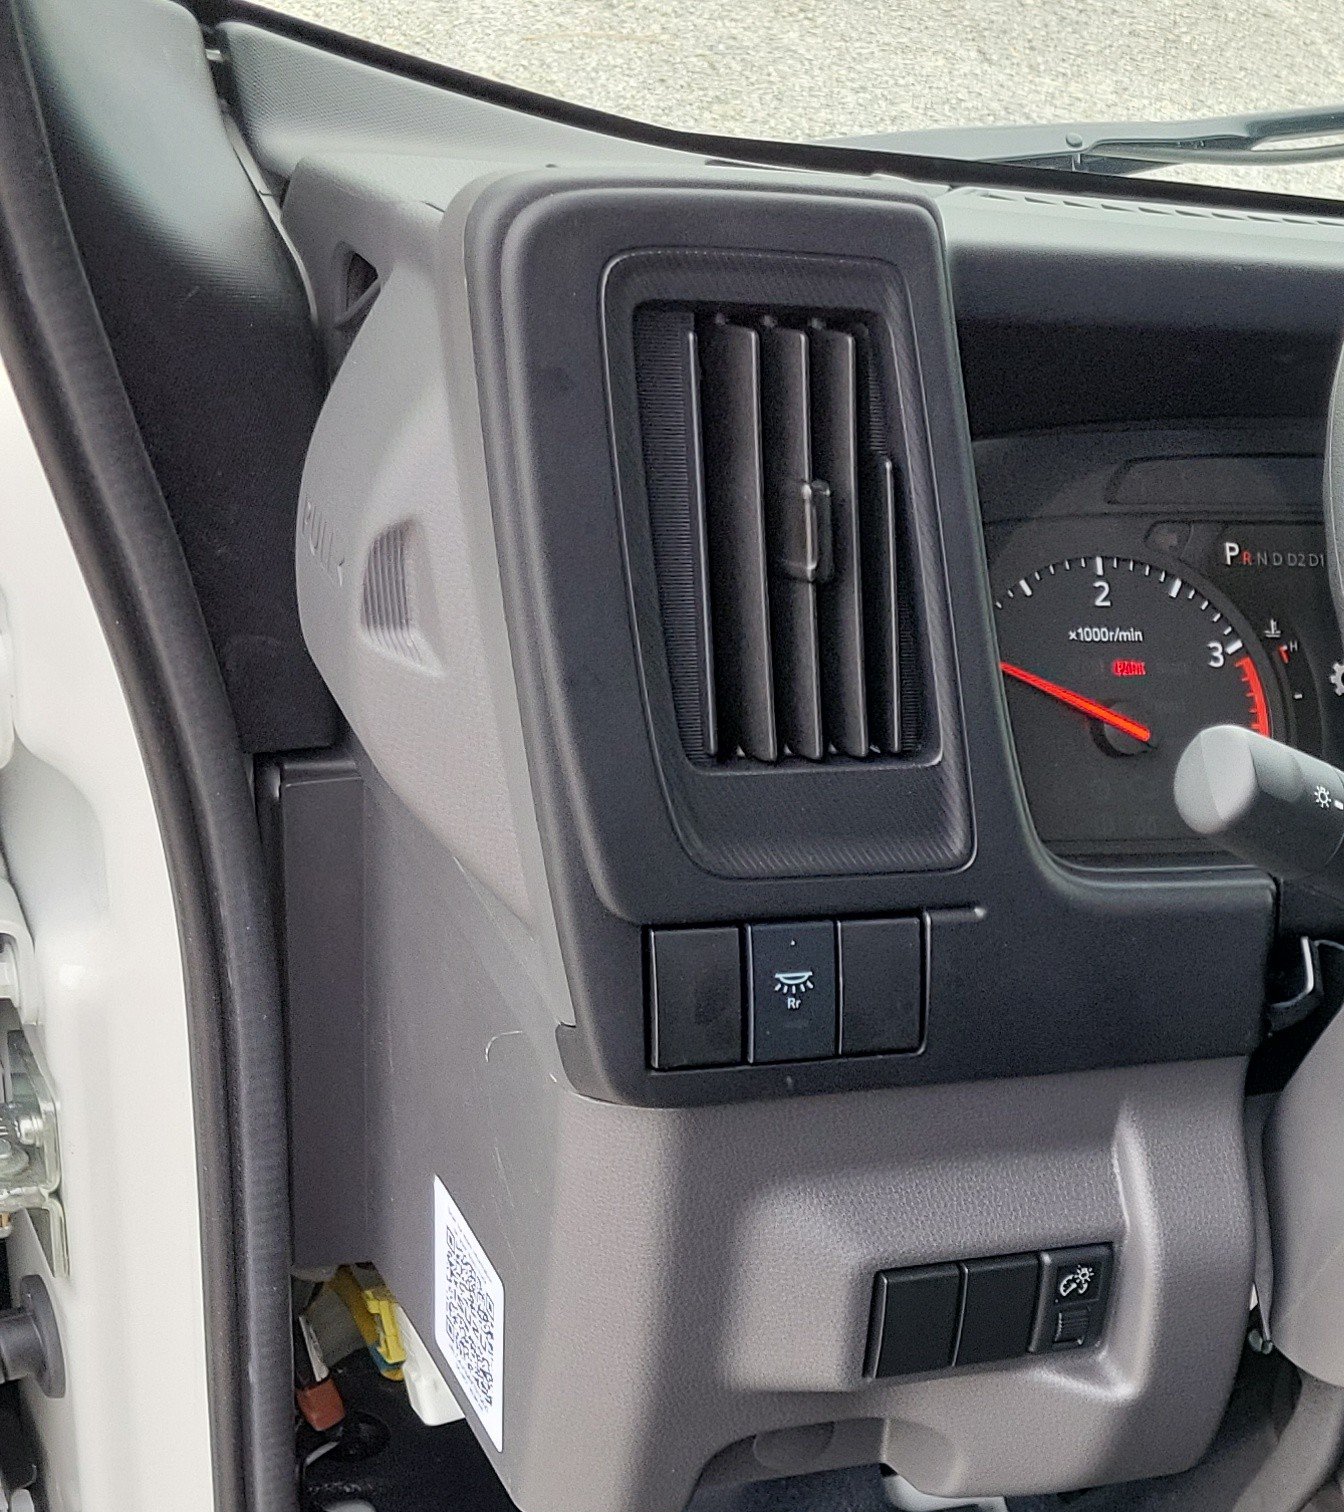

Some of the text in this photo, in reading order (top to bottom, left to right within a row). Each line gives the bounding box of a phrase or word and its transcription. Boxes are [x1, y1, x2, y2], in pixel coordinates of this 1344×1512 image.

[1225, 542, 1239, 565] P
[1243, 551, 1251, 565] R
[1257, 551, 1267, 566] N
[1273, 552, 1283, 565] D
[1288, 553, 1306, 566] D2
[1093, 581, 1111, 607] 2
[1207, 641, 1225, 668] 3
[787, 998, 801, 1010] Rr
